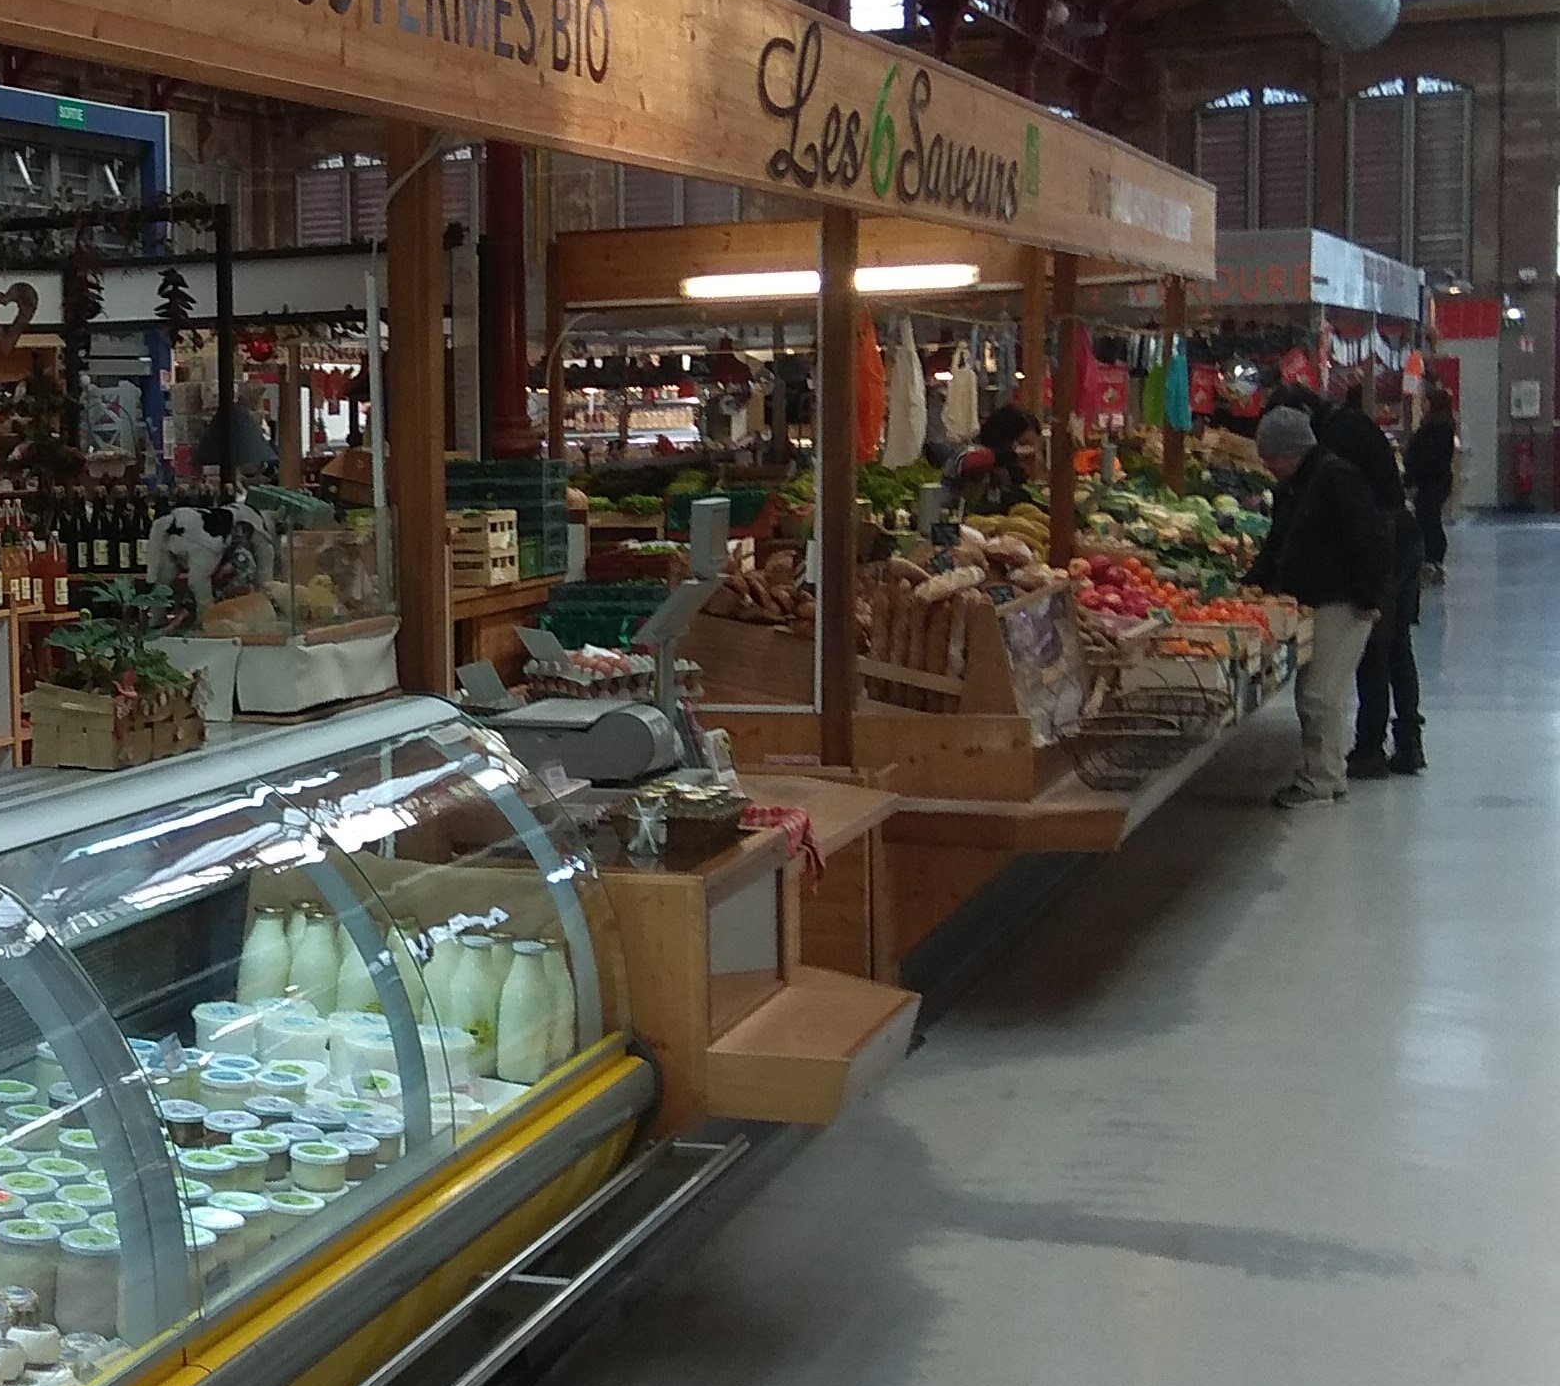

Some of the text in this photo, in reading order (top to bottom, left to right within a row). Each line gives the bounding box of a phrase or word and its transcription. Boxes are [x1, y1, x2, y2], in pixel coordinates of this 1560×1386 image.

[757, 22, 862, 190] Les
[870, 63, 898, 196] 6
[896, 68, 1020, 224] Saveurs
